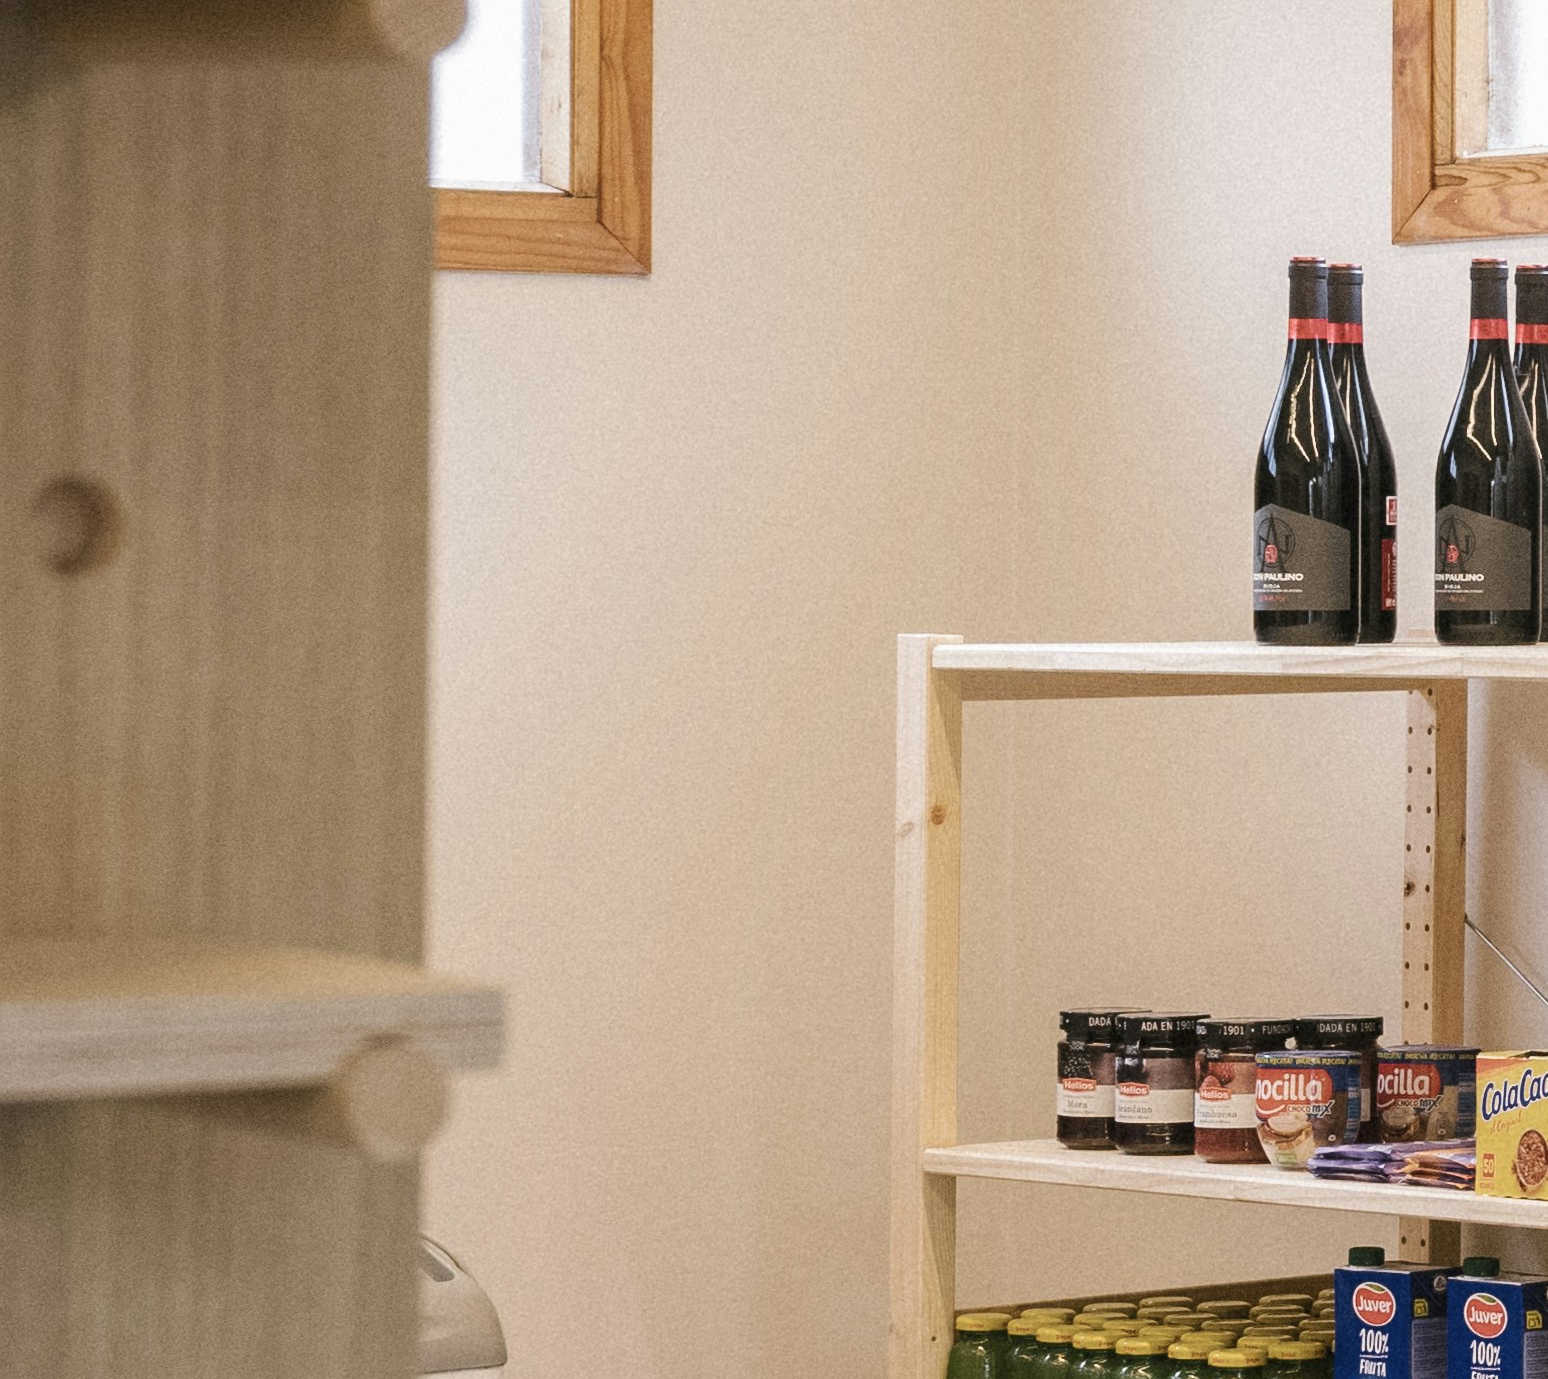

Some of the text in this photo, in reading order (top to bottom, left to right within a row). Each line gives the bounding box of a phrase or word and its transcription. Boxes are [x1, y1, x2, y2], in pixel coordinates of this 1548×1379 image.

[1264, 573, 1304, 582] PAULINO
[1445, 573, 1485, 583] PAULINO
[1161, 1023, 1173, 1031] EN
[1223, 1025, 1245, 1036] 1901
[1346, 1023, 1358, 1033] EN
[1064, 1079, 1095, 1090] Helios
[1376, 1067, 1430, 1096] ocilla
[1120, 1084, 1148, 1095] Helios
[1201, 1089, 1230, 1100] Helios
[1286, 1104, 1311, 1113] CHOCO
[1396, 1099, 1419, 1107] CHOCO
[1357, 1294, 1393, 1314] Juver
[1468, 1305, 1504, 1326] Juver
[1359, 1328, 1390, 1354] 100%
[1470, 1339, 1501, 1366] 100%
[1359, 1358, 1387, 1377] FRUTA
